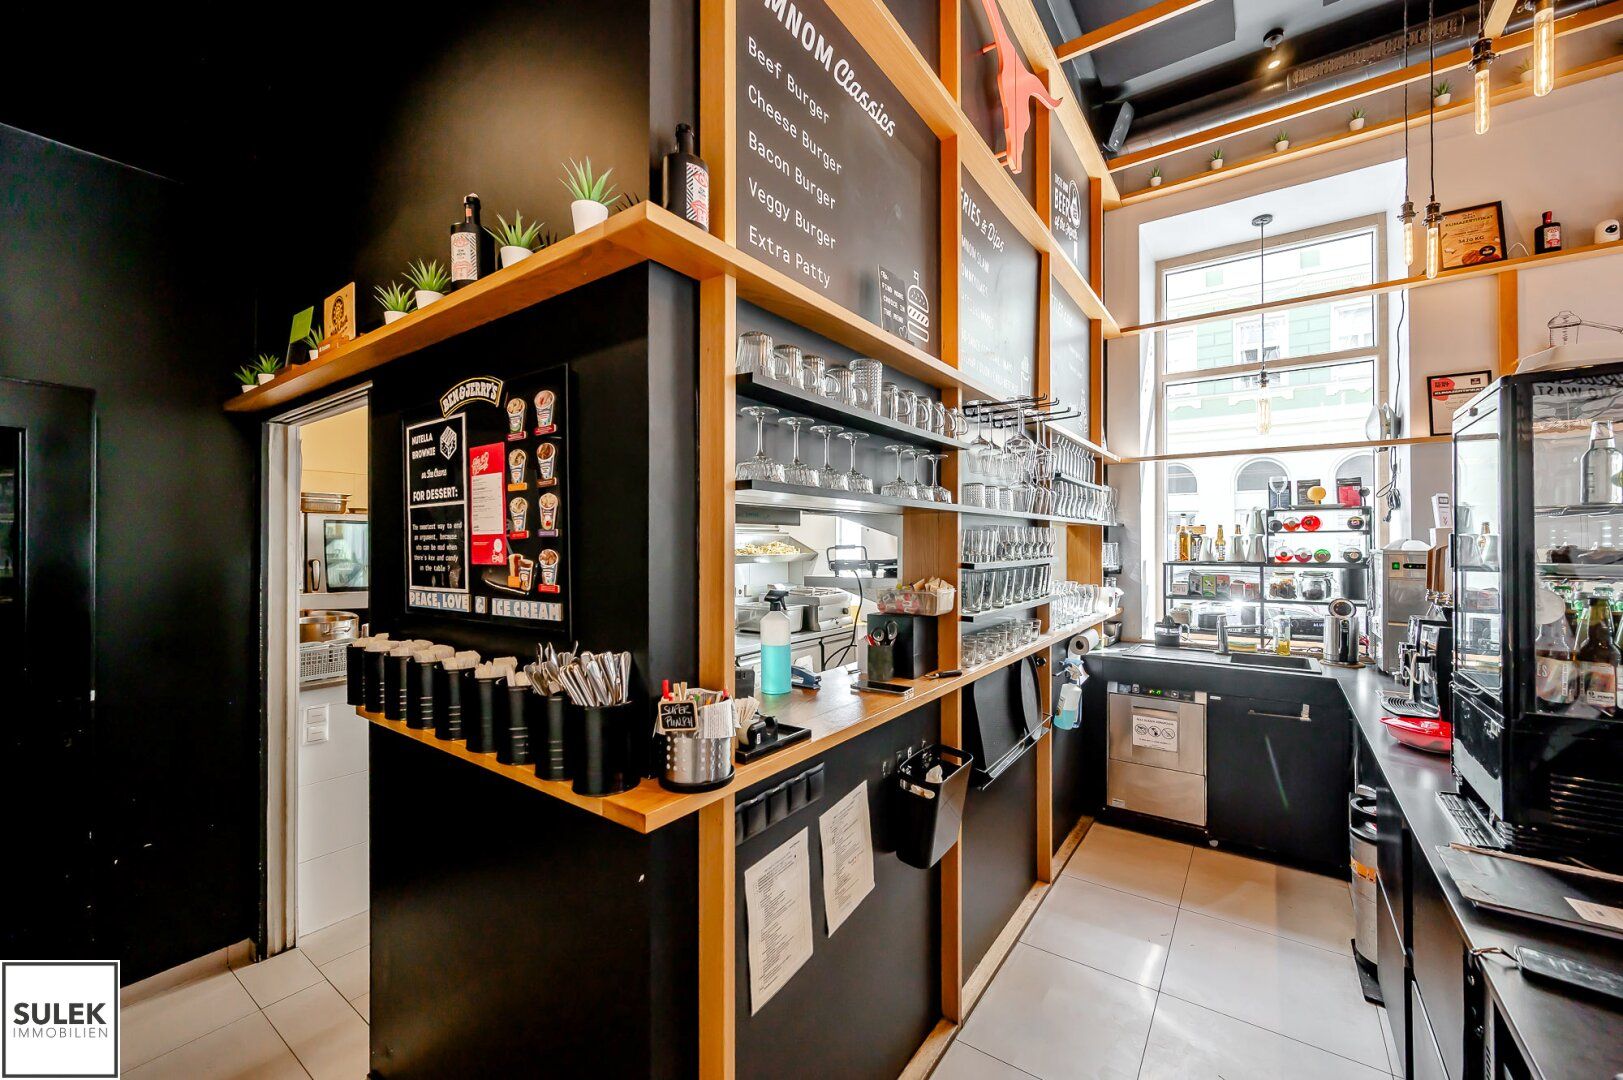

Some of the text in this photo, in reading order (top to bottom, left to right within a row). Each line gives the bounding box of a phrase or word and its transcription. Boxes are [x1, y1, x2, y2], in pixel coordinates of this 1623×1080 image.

[748, 36, 829, 124] Beef Burger
[834, 59, 896, 137] Classics
[748, 85, 842, 175] Cheese Burger
[748, 130, 836, 209] Bacon Burger
[748, 177, 836, 249] Veggy Burger
[1055, 187, 1072, 223] BEER
[988, 223, 1005, 253] Dips
[748, 225, 830, 288] Extra Patty
[411, 432, 433, 446] NUTELLA
[411, 446, 436, 460] BROWNIE
[413, 486, 458, 502] FOR DESSERT:
[409, 591, 441, 609] PEACE,
[442, 593, 469, 612] LOVE
[492, 598, 511, 617] ICE
[513, 601, 562, 622] CREAM
[662, 704, 691, 716] SUPER
